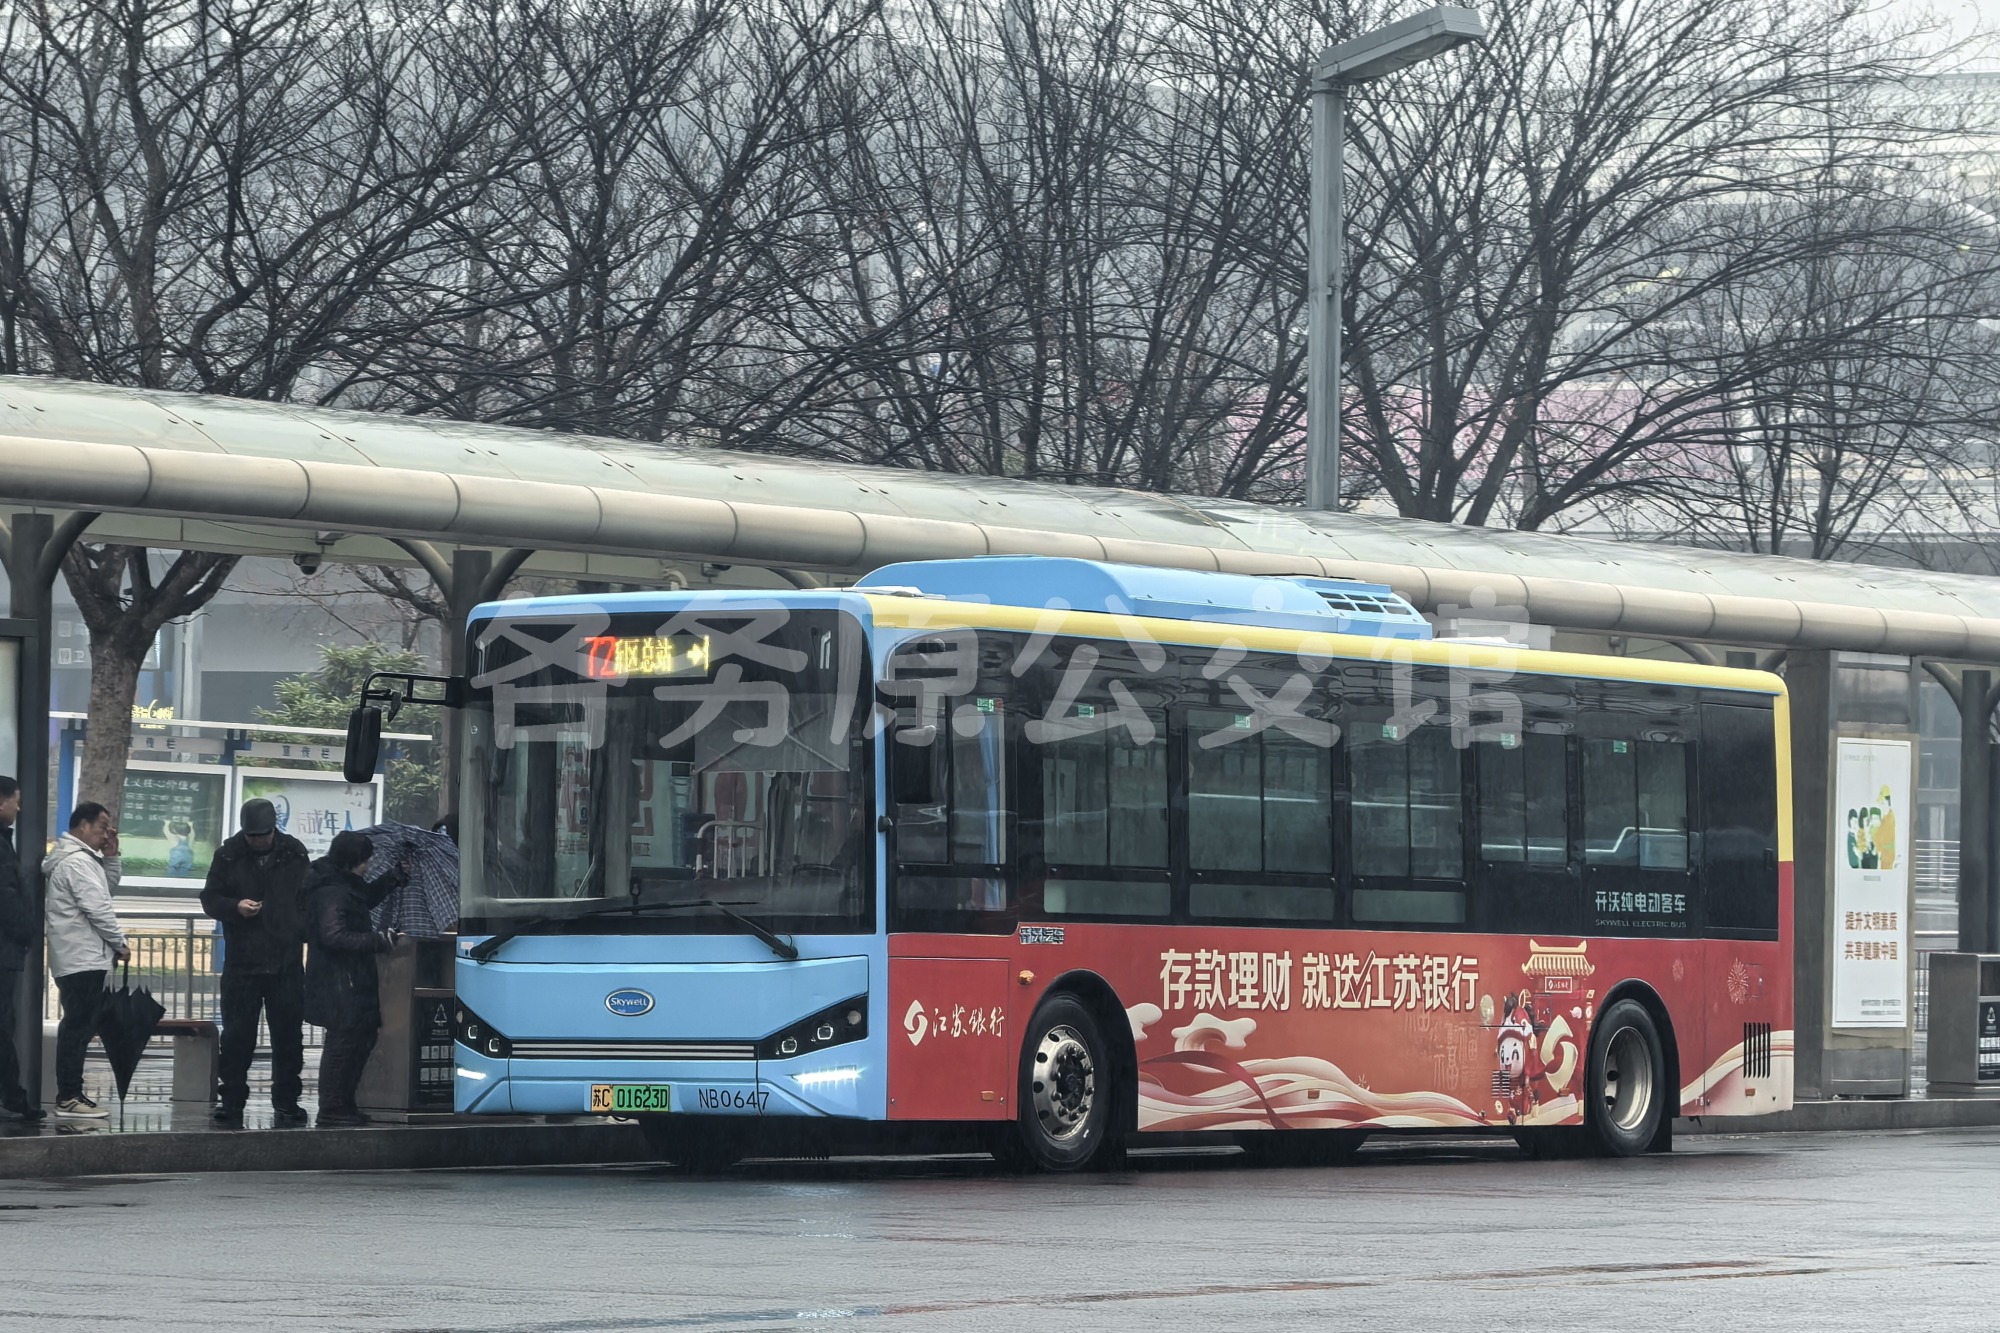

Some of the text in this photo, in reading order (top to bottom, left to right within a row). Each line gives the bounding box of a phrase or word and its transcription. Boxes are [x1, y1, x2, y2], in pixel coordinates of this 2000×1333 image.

[583, 635, 617, 677] 72
[1595, 890, 1686, 914] 开沃纯电动客车
[1595, 919, 1687, 929] SKYWELL ELECTRIC BUS
[1159, 947, 1480, 1012] 存款理财 就选江苏银行
[610, 997, 648, 1007] Skywell
[698, 1088, 770, 1111] NB0647
